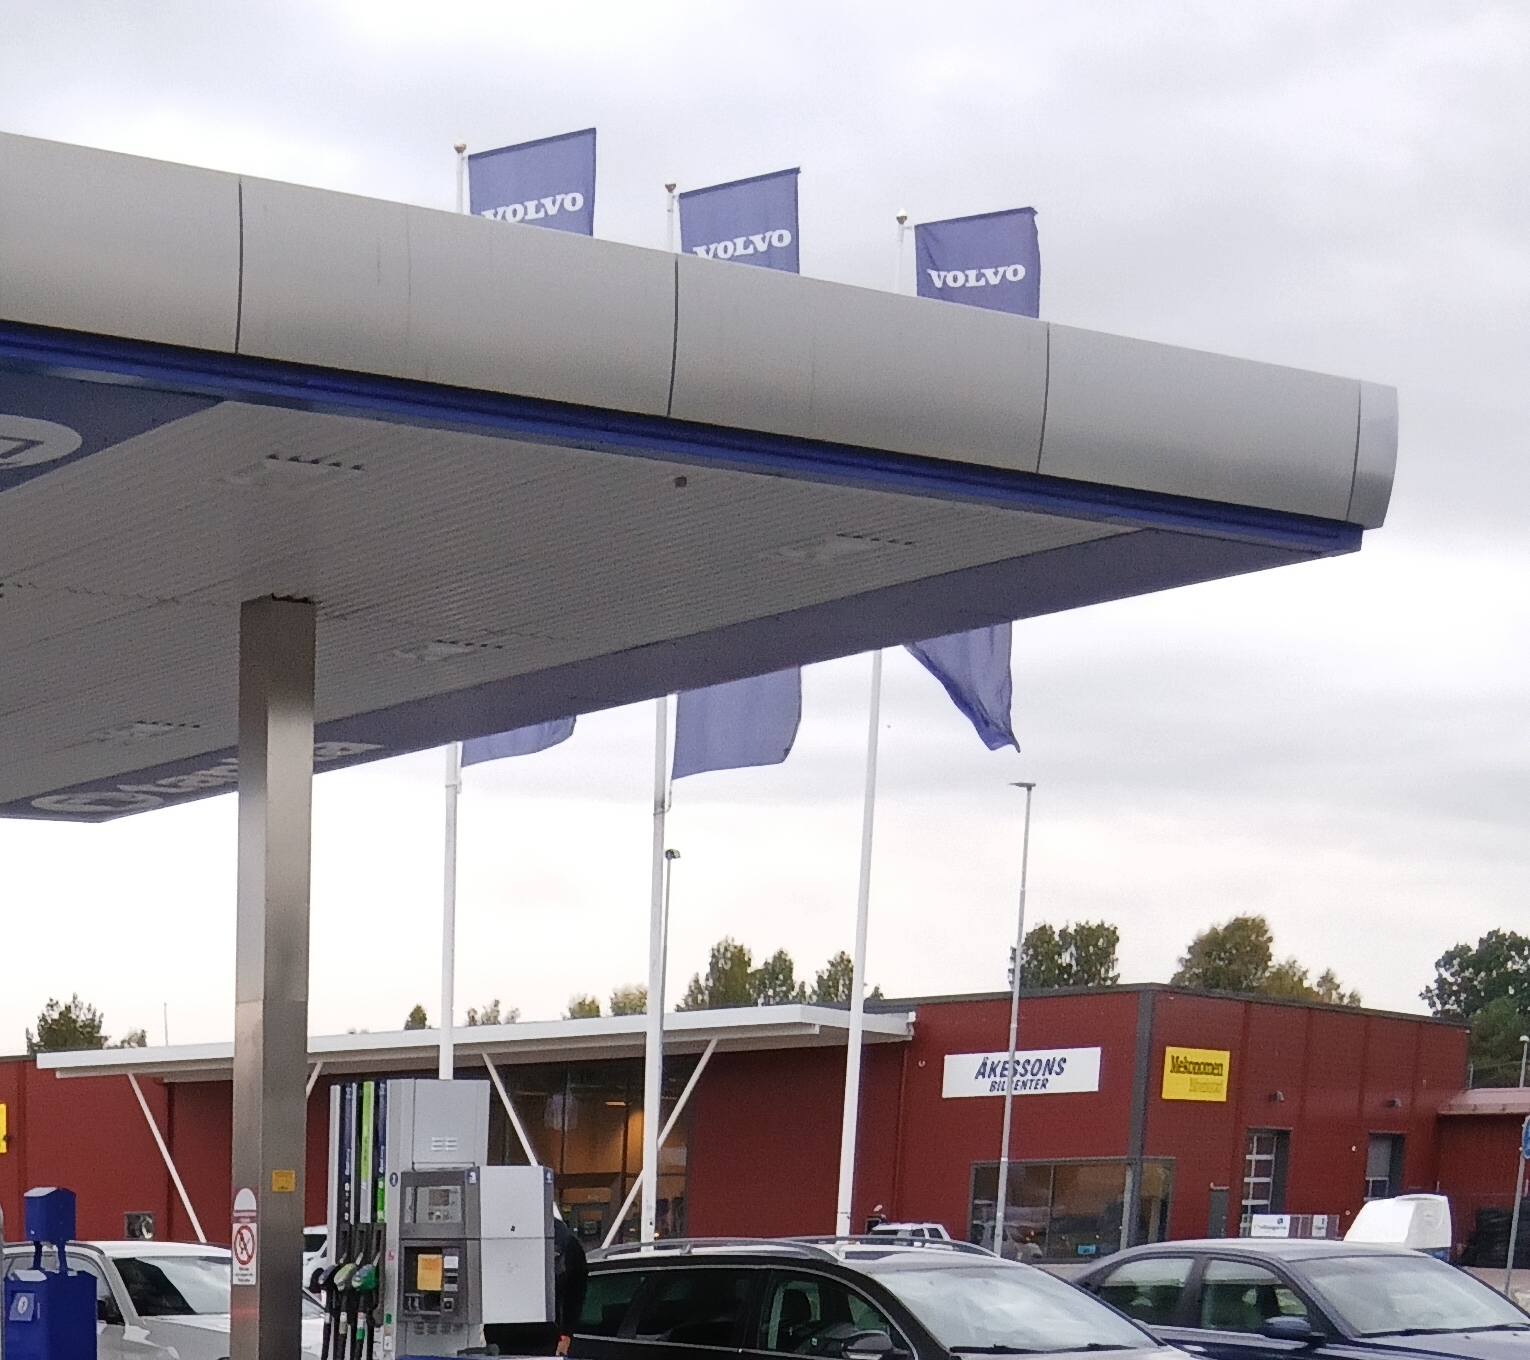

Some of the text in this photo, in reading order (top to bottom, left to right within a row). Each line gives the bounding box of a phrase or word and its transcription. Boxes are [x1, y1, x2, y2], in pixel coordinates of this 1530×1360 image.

[481, 193, 584, 222] VOLVO
[693, 229, 792, 259] VOLVO
[926, 264, 1026, 288] VOLVO
[974, 1056, 1068, 1080] ÅKESSONS
[989, 1078, 1049, 1092] BILENTER
